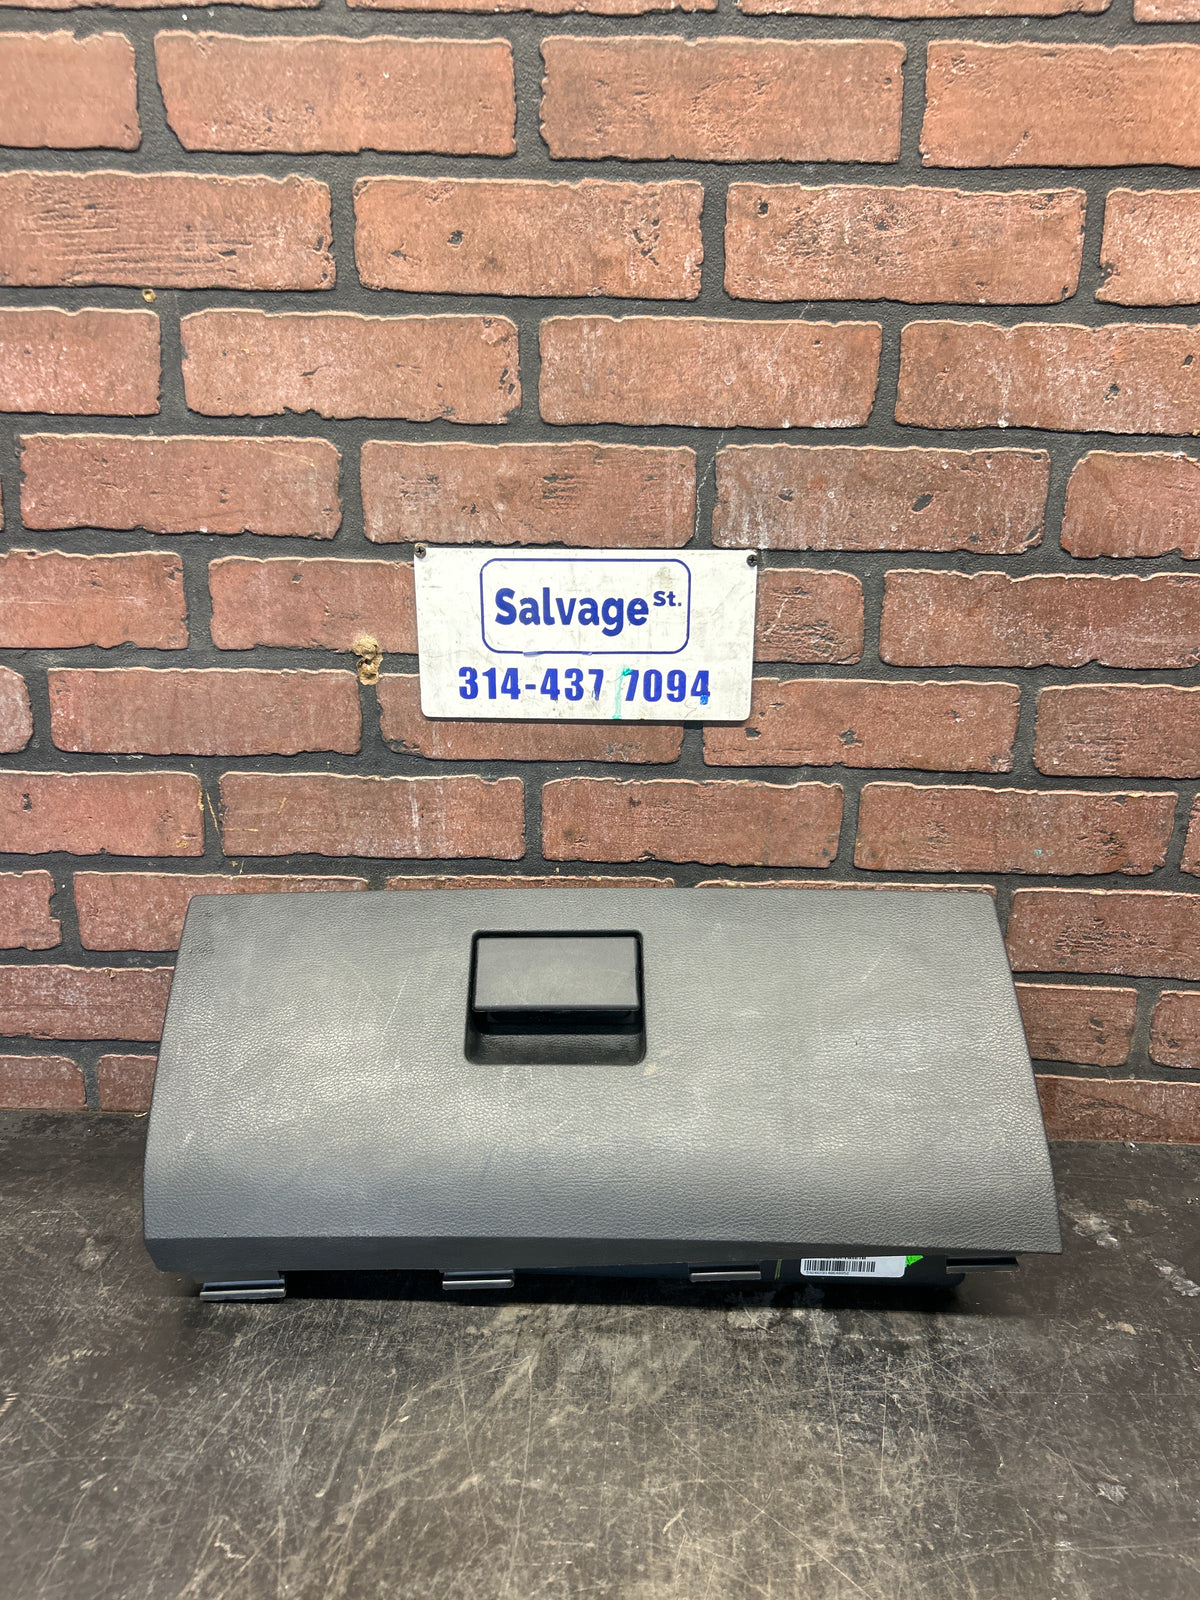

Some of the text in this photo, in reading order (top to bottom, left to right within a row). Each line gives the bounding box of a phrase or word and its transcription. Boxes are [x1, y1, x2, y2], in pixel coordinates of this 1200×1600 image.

[495, 587, 682, 637] Salvage St.
[459, 667, 711, 705] 314-437 7094
